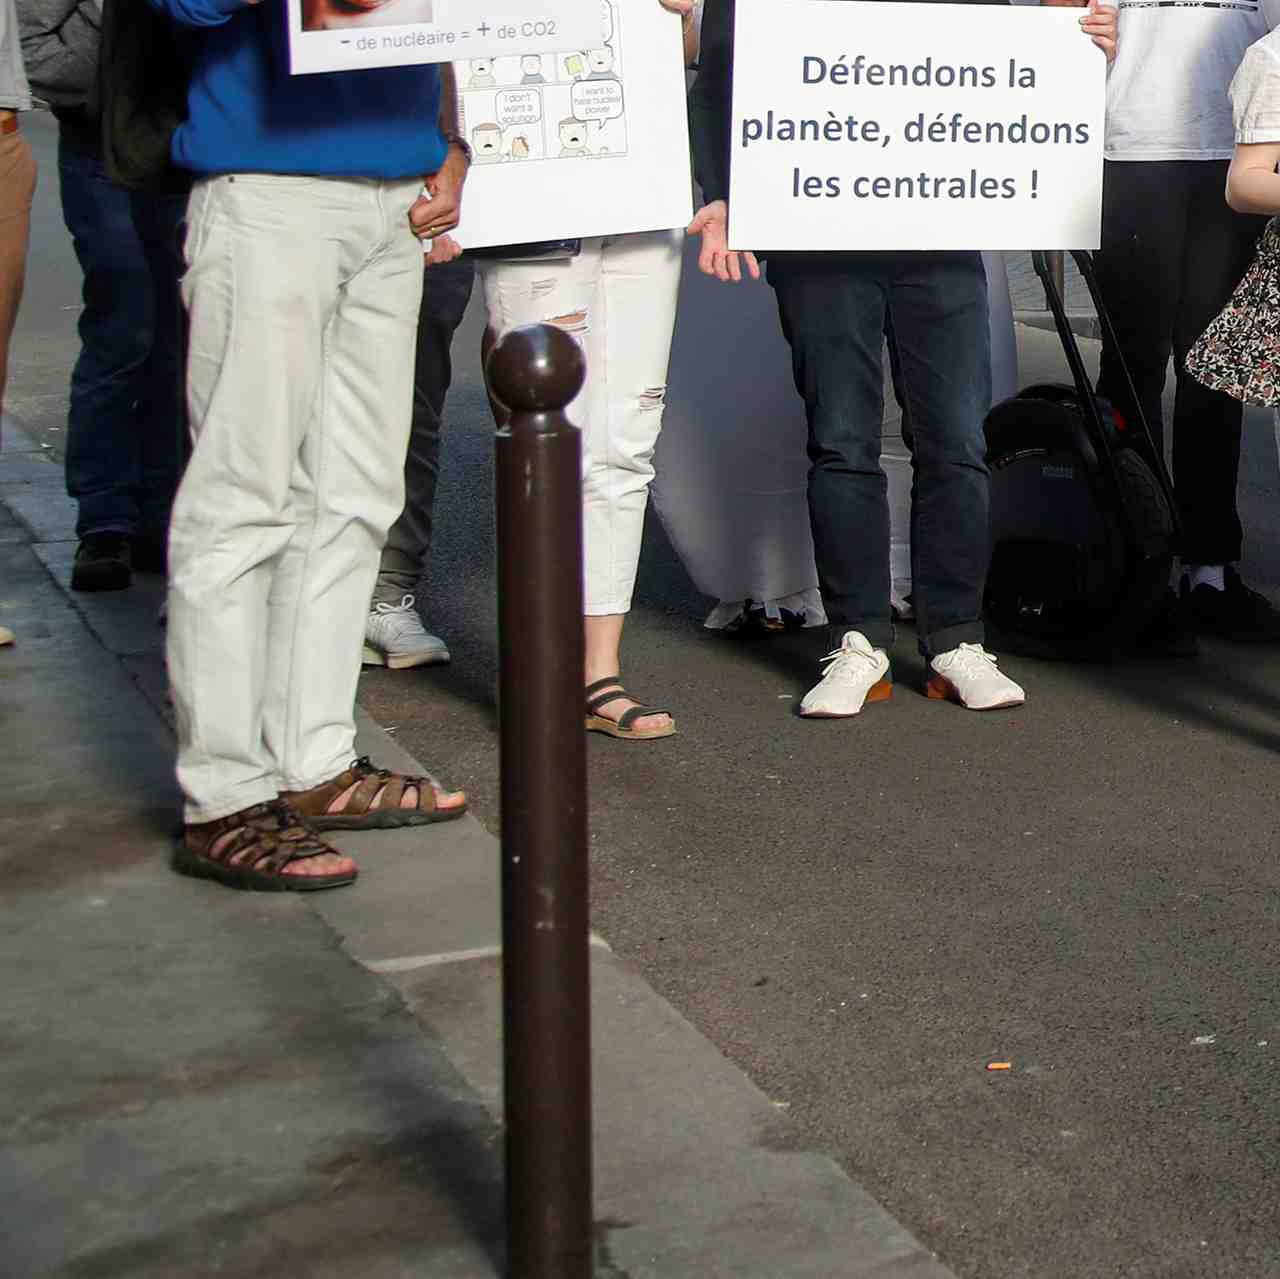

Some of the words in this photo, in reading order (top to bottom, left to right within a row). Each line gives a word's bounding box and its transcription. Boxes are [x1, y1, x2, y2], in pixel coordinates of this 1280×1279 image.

[356, 32, 377, 51] de
[381, 26, 456, 49] nucléaire
[497, 22, 517, 40] de
[521, 20, 557, 38] CO2
[802, 55, 997, 89] Défendons
[1008, 58, 1036, 89] la
[741, 110, 891, 147] planète,
[903, 113, 1090, 144] défendons
[792, 167, 841, 198] les
[853, 168, 1017, 199] centrales
[1029, 169, 1039, 198] !
